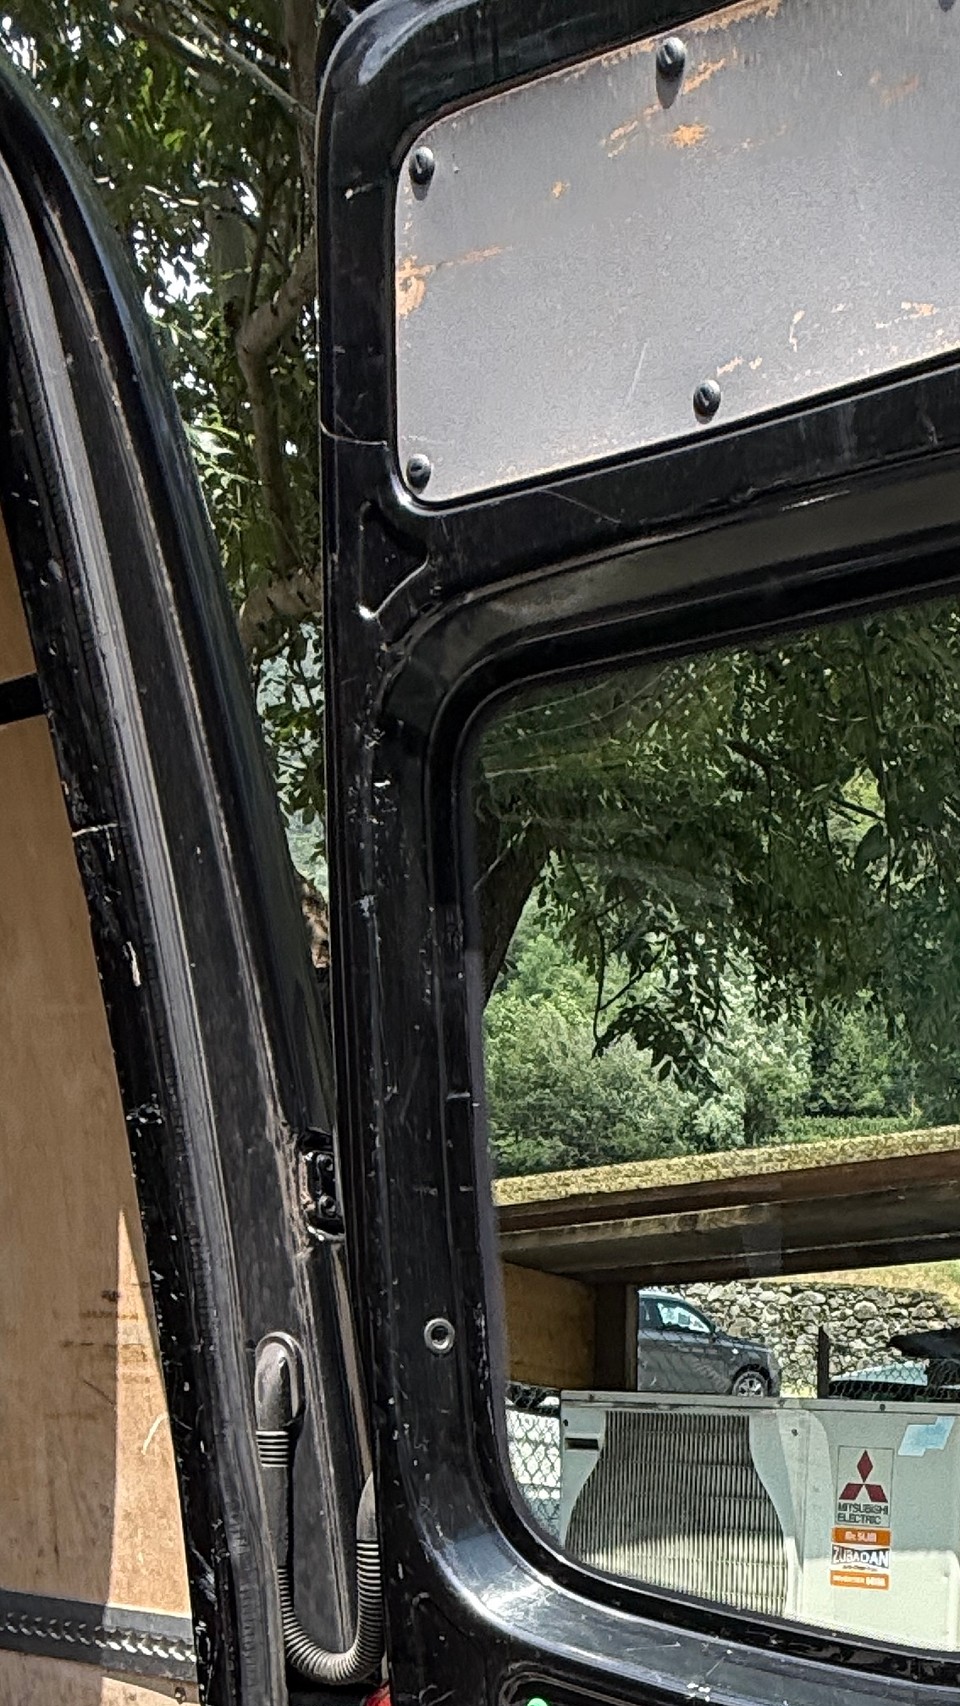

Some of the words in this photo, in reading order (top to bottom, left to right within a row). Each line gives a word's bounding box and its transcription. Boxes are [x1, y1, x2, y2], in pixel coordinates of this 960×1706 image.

[838, 1502, 888, 1515] MITSUBISHI
[837, 1513, 882, 1525] ELECTRIC
[832, 1546, 889, 1568] ZUBADAN
